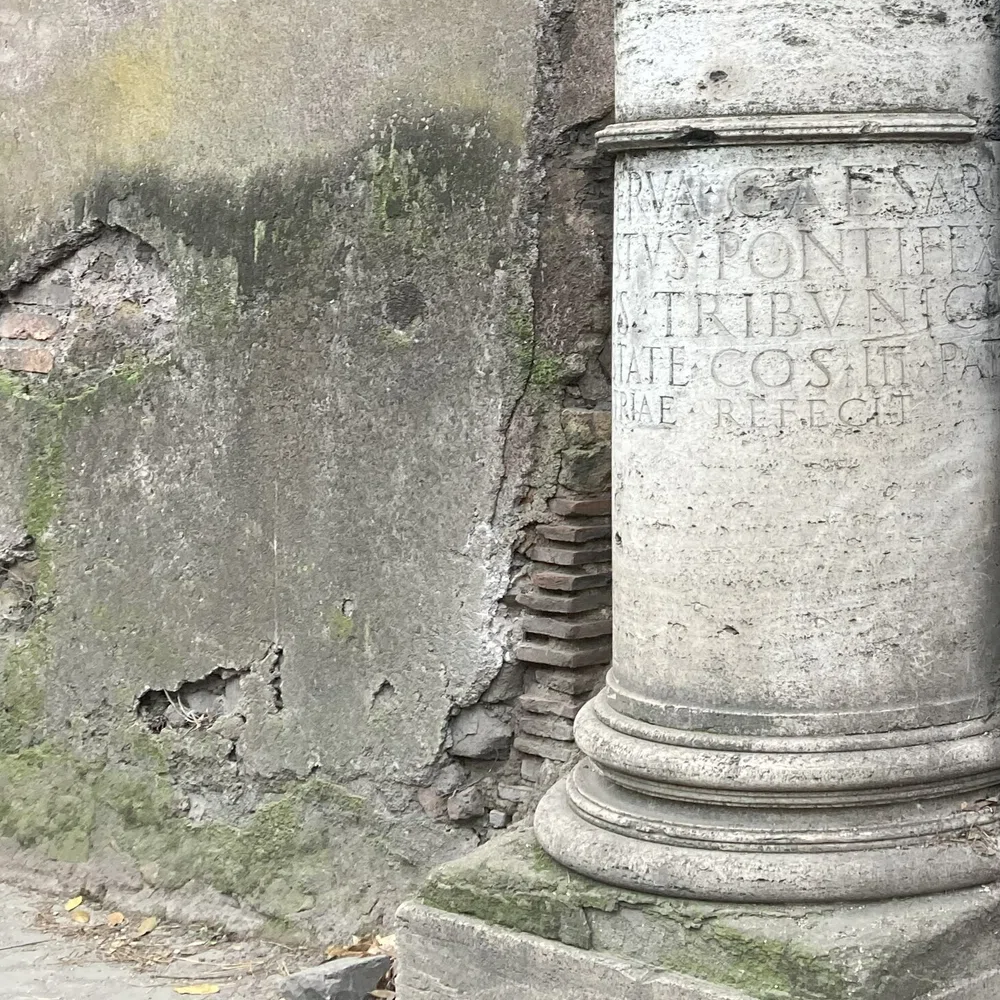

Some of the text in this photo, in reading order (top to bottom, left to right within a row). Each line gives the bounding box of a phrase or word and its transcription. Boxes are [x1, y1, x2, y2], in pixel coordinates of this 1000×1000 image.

[727, 163, 993, 220] CAESAR
[710, 346, 835, 388] COS
[714, 393, 914, 429] REFECIT
